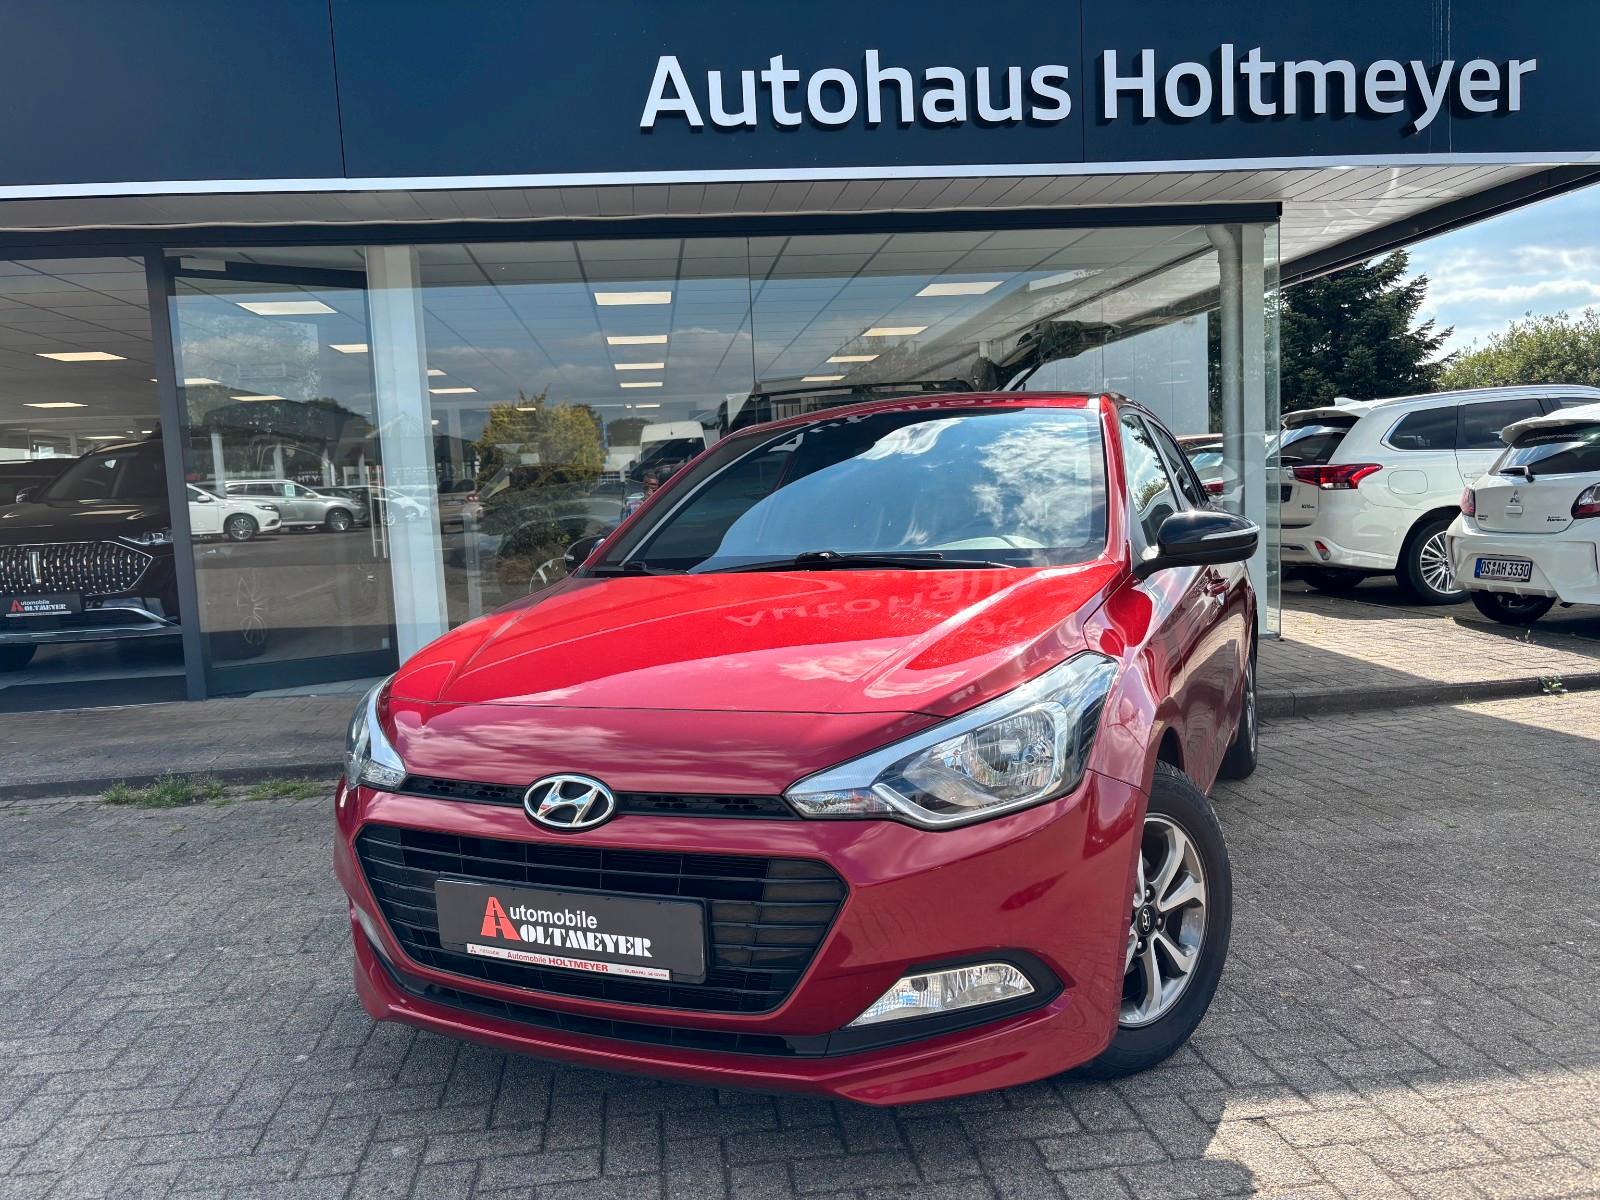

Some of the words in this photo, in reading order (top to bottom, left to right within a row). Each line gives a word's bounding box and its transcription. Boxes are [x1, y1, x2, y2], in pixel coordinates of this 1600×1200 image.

[640, 48, 1072, 128] Autohaus
[1102, 43, 1537, 133] Holtmeyer
[1480, 561, 1491, 574] OS
[1495, 562, 1508, 576] AH
[1508, 563, 1530, 578] 3330
[507, 951, 547, 965] Automobile
[548, 957, 609, 973] HOLTMEYER
